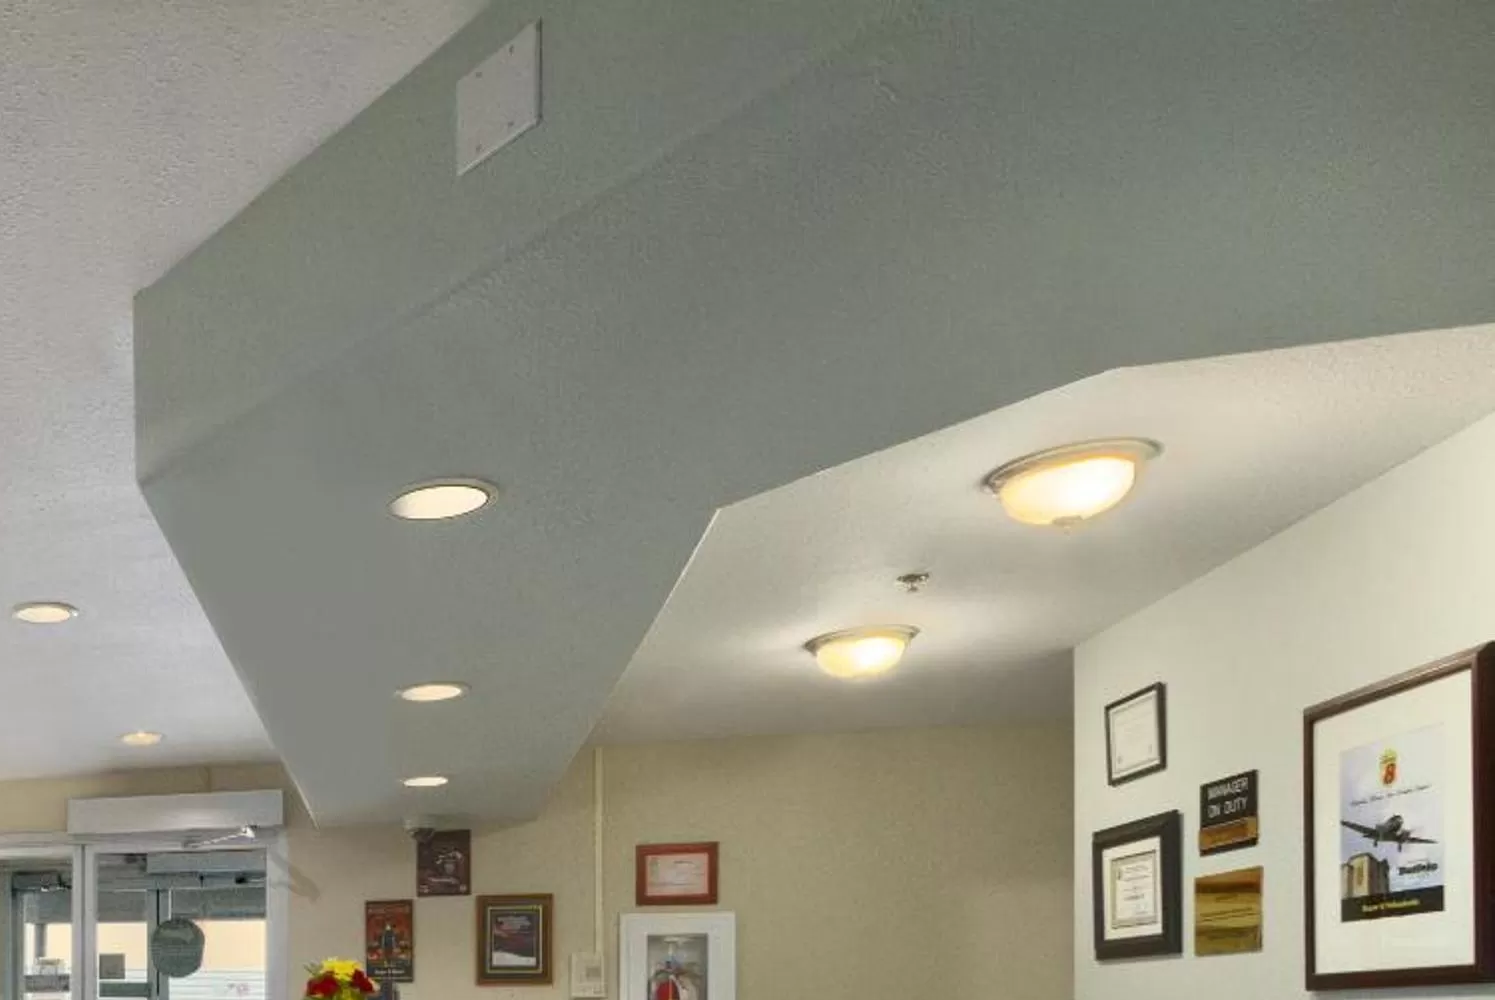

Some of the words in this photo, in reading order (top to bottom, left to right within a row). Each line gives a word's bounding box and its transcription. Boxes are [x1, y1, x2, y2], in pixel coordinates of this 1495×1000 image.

[1207, 776, 1249, 801] MANAGER
[1207, 803, 1221, 819] ON
[1223, 795, 1248, 815] DUTY
